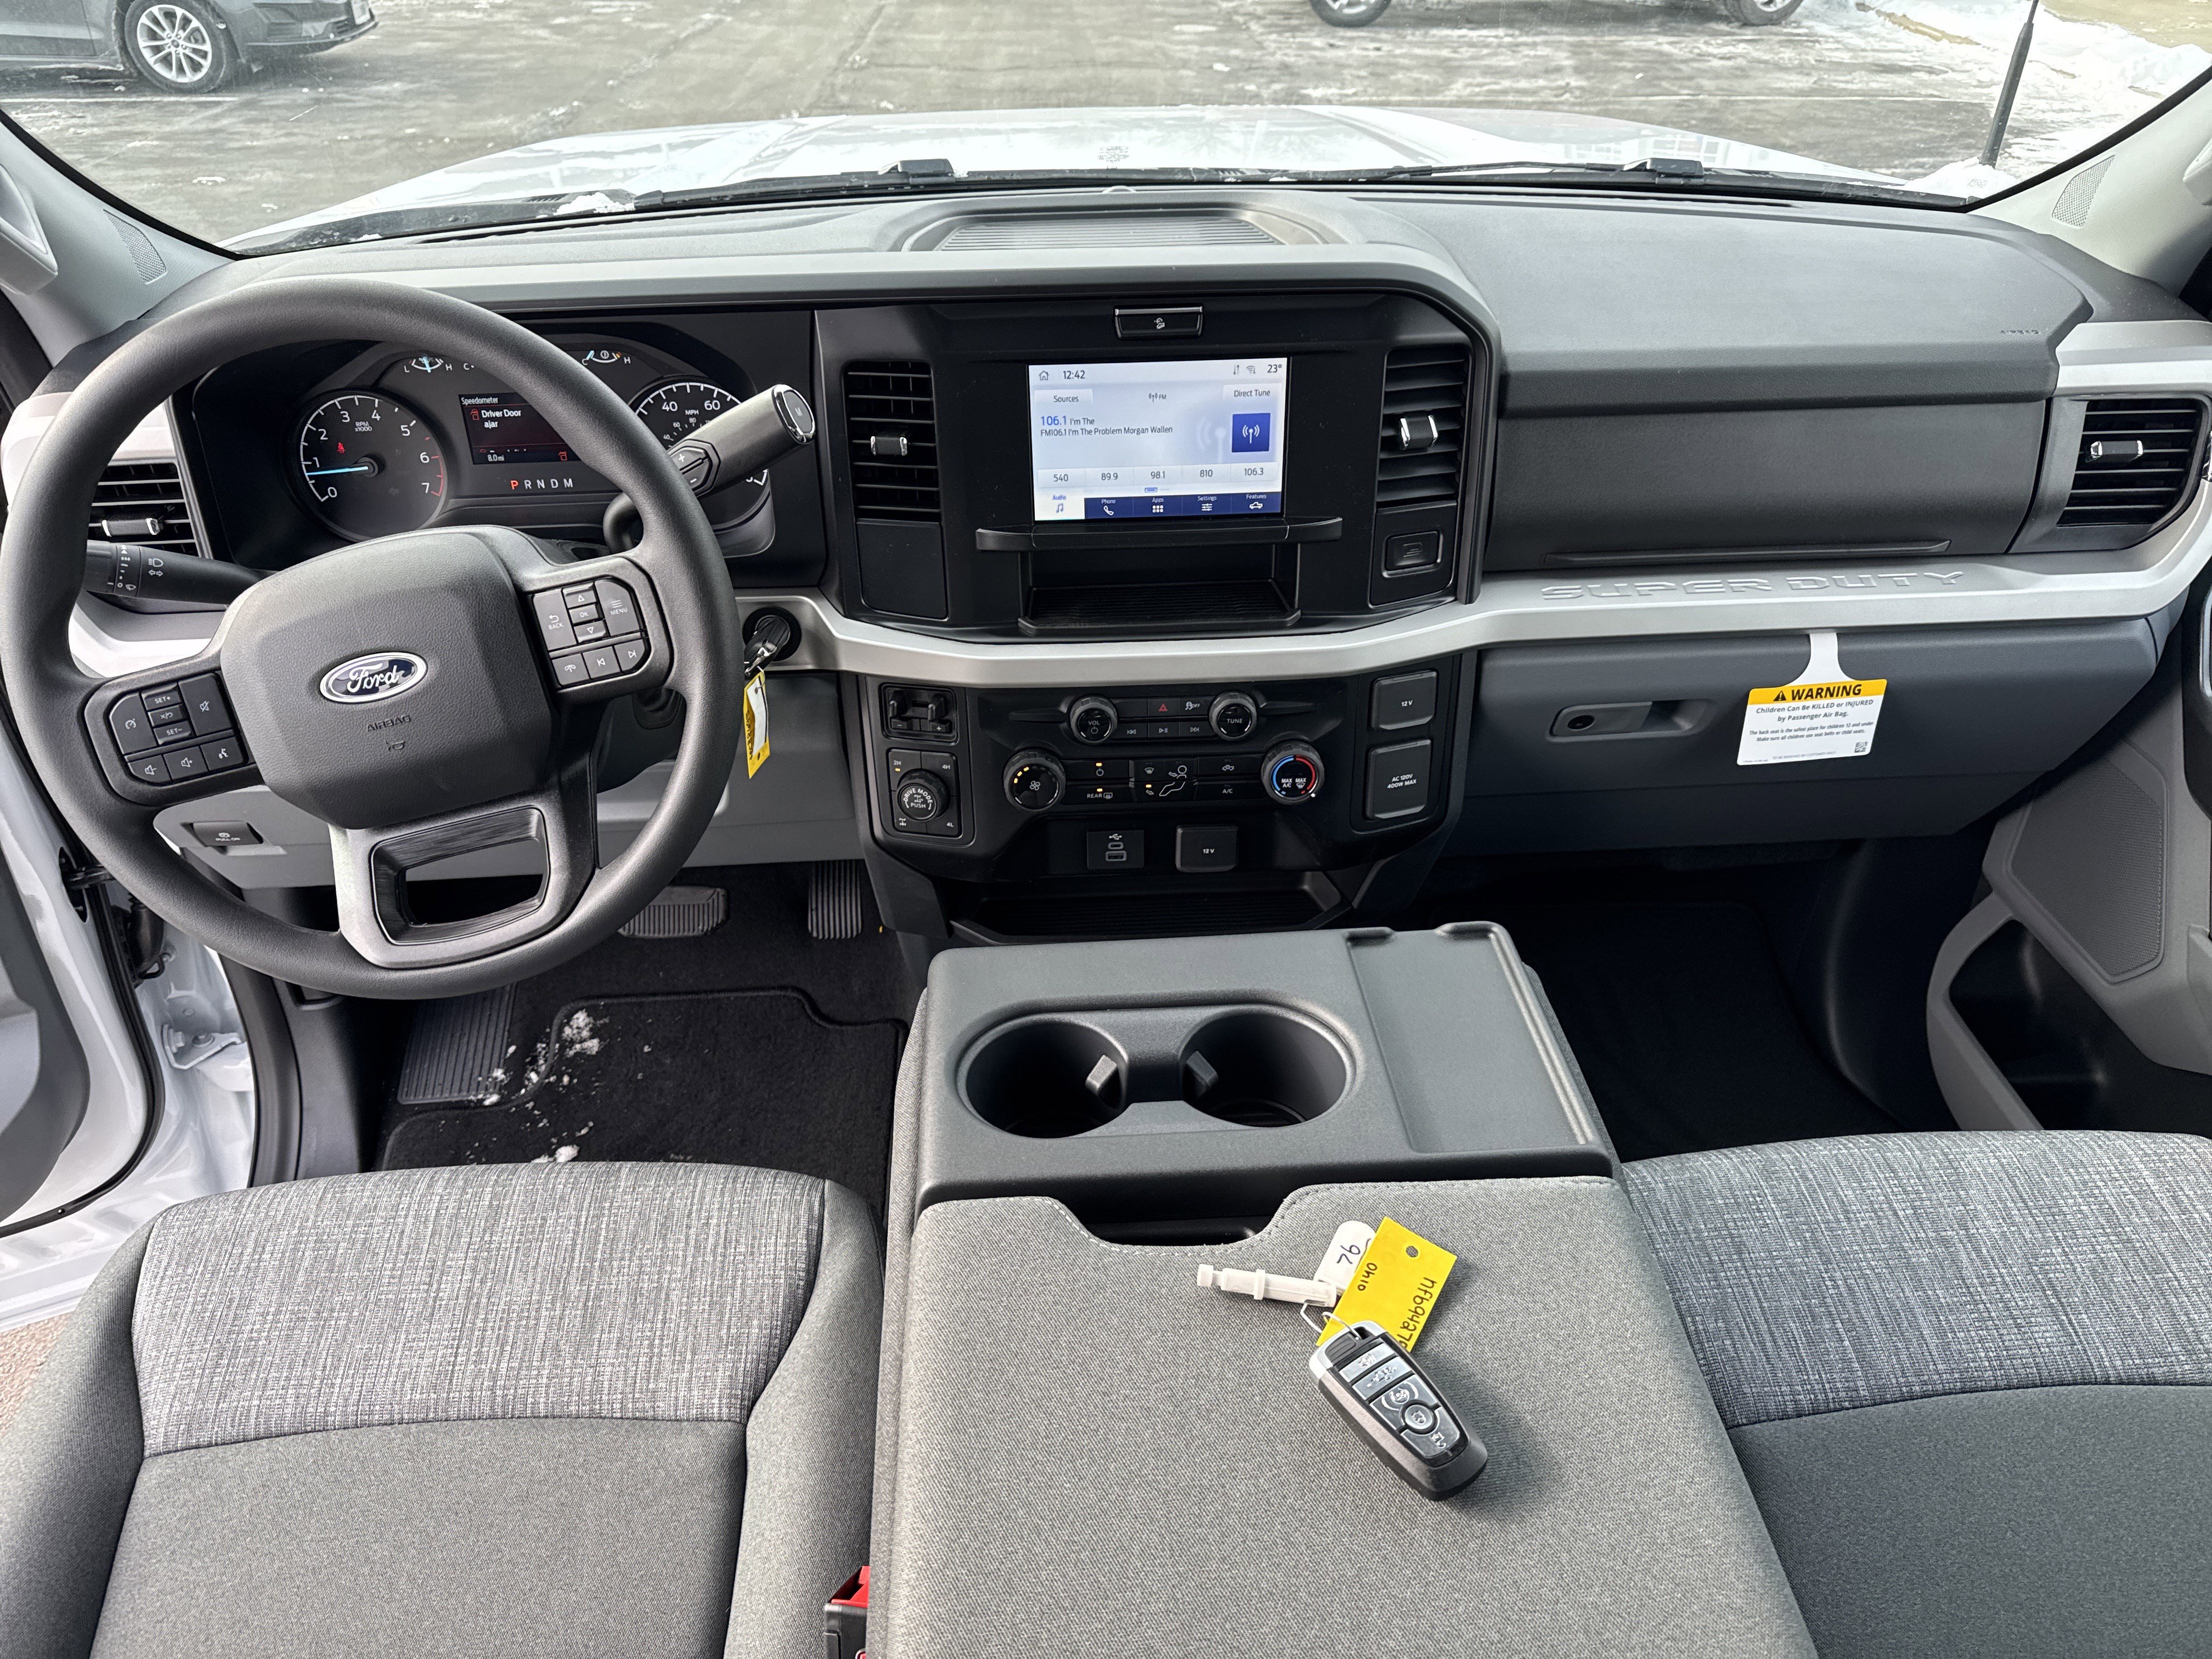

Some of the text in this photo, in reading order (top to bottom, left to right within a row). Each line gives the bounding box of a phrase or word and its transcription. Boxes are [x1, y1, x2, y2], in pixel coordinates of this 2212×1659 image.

[1063, 370, 1086, 380] 12:42
[1053, 394, 1079, 403] Sources
[1234, 390, 1252, 398] Direct
[461, 397, 499, 405] Speedometer
[704, 400, 720, 410] 60
[662, 401, 678, 412] 40
[340, 411, 350, 422] 3
[371, 410, 381, 421] 4
[484, 420, 498, 430] ajar
[1041, 416, 1066, 426] 106.1
[318, 428, 328, 440] 2
[400, 425, 410, 436] 5
[1094, 427, 1122, 435] Problem
[1124, 426, 1149, 435] Morgan
[313, 457, 319, 467] 1
[420, 452, 430, 464] 6
[1101, 472, 1118, 481] 89.9
[1150, 471, 1166, 479] 98.1
[1199, 470, 1214, 478] 810
[1244, 468, 1264, 476] 106.3
[1053, 474, 1069, 482] 540
[421, 482, 430, 494] 7
[510, 478, 573, 490] P R N D M
[328, 487, 337, 498] 0
[1541, 571, 1963, 600] SUPER DUTY
[610, 607, 628, 616] MENU
[347, 663, 399, 693] Ford
[1791, 684, 1863, 701] WARNING
[1845, 699, 1874, 708] INJURED
[366, 715, 411, 732] AIRBAG
[903, 788, 933, 804] DRIVE MODE
